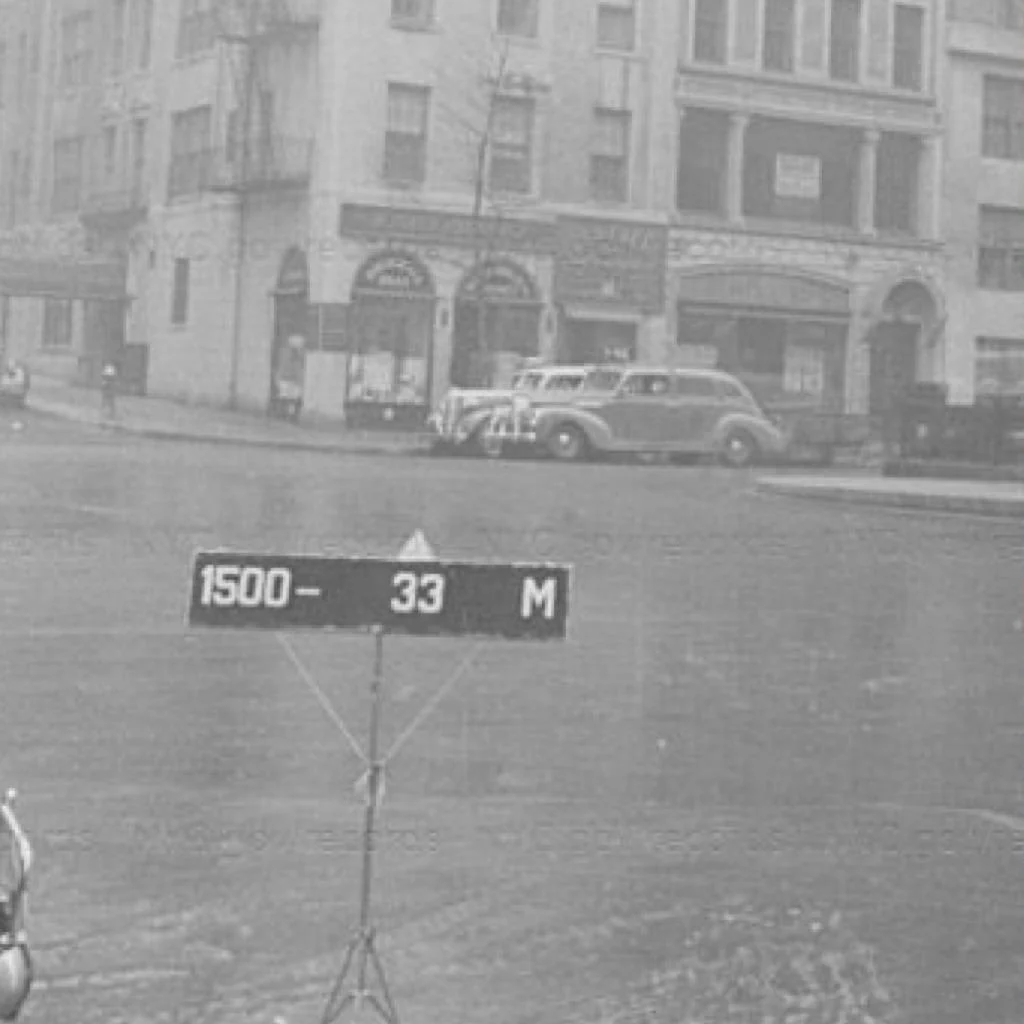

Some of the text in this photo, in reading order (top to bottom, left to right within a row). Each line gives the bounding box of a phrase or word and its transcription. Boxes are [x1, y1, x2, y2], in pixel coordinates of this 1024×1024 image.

[201, 564, 557, 619] 1500- 33 M
